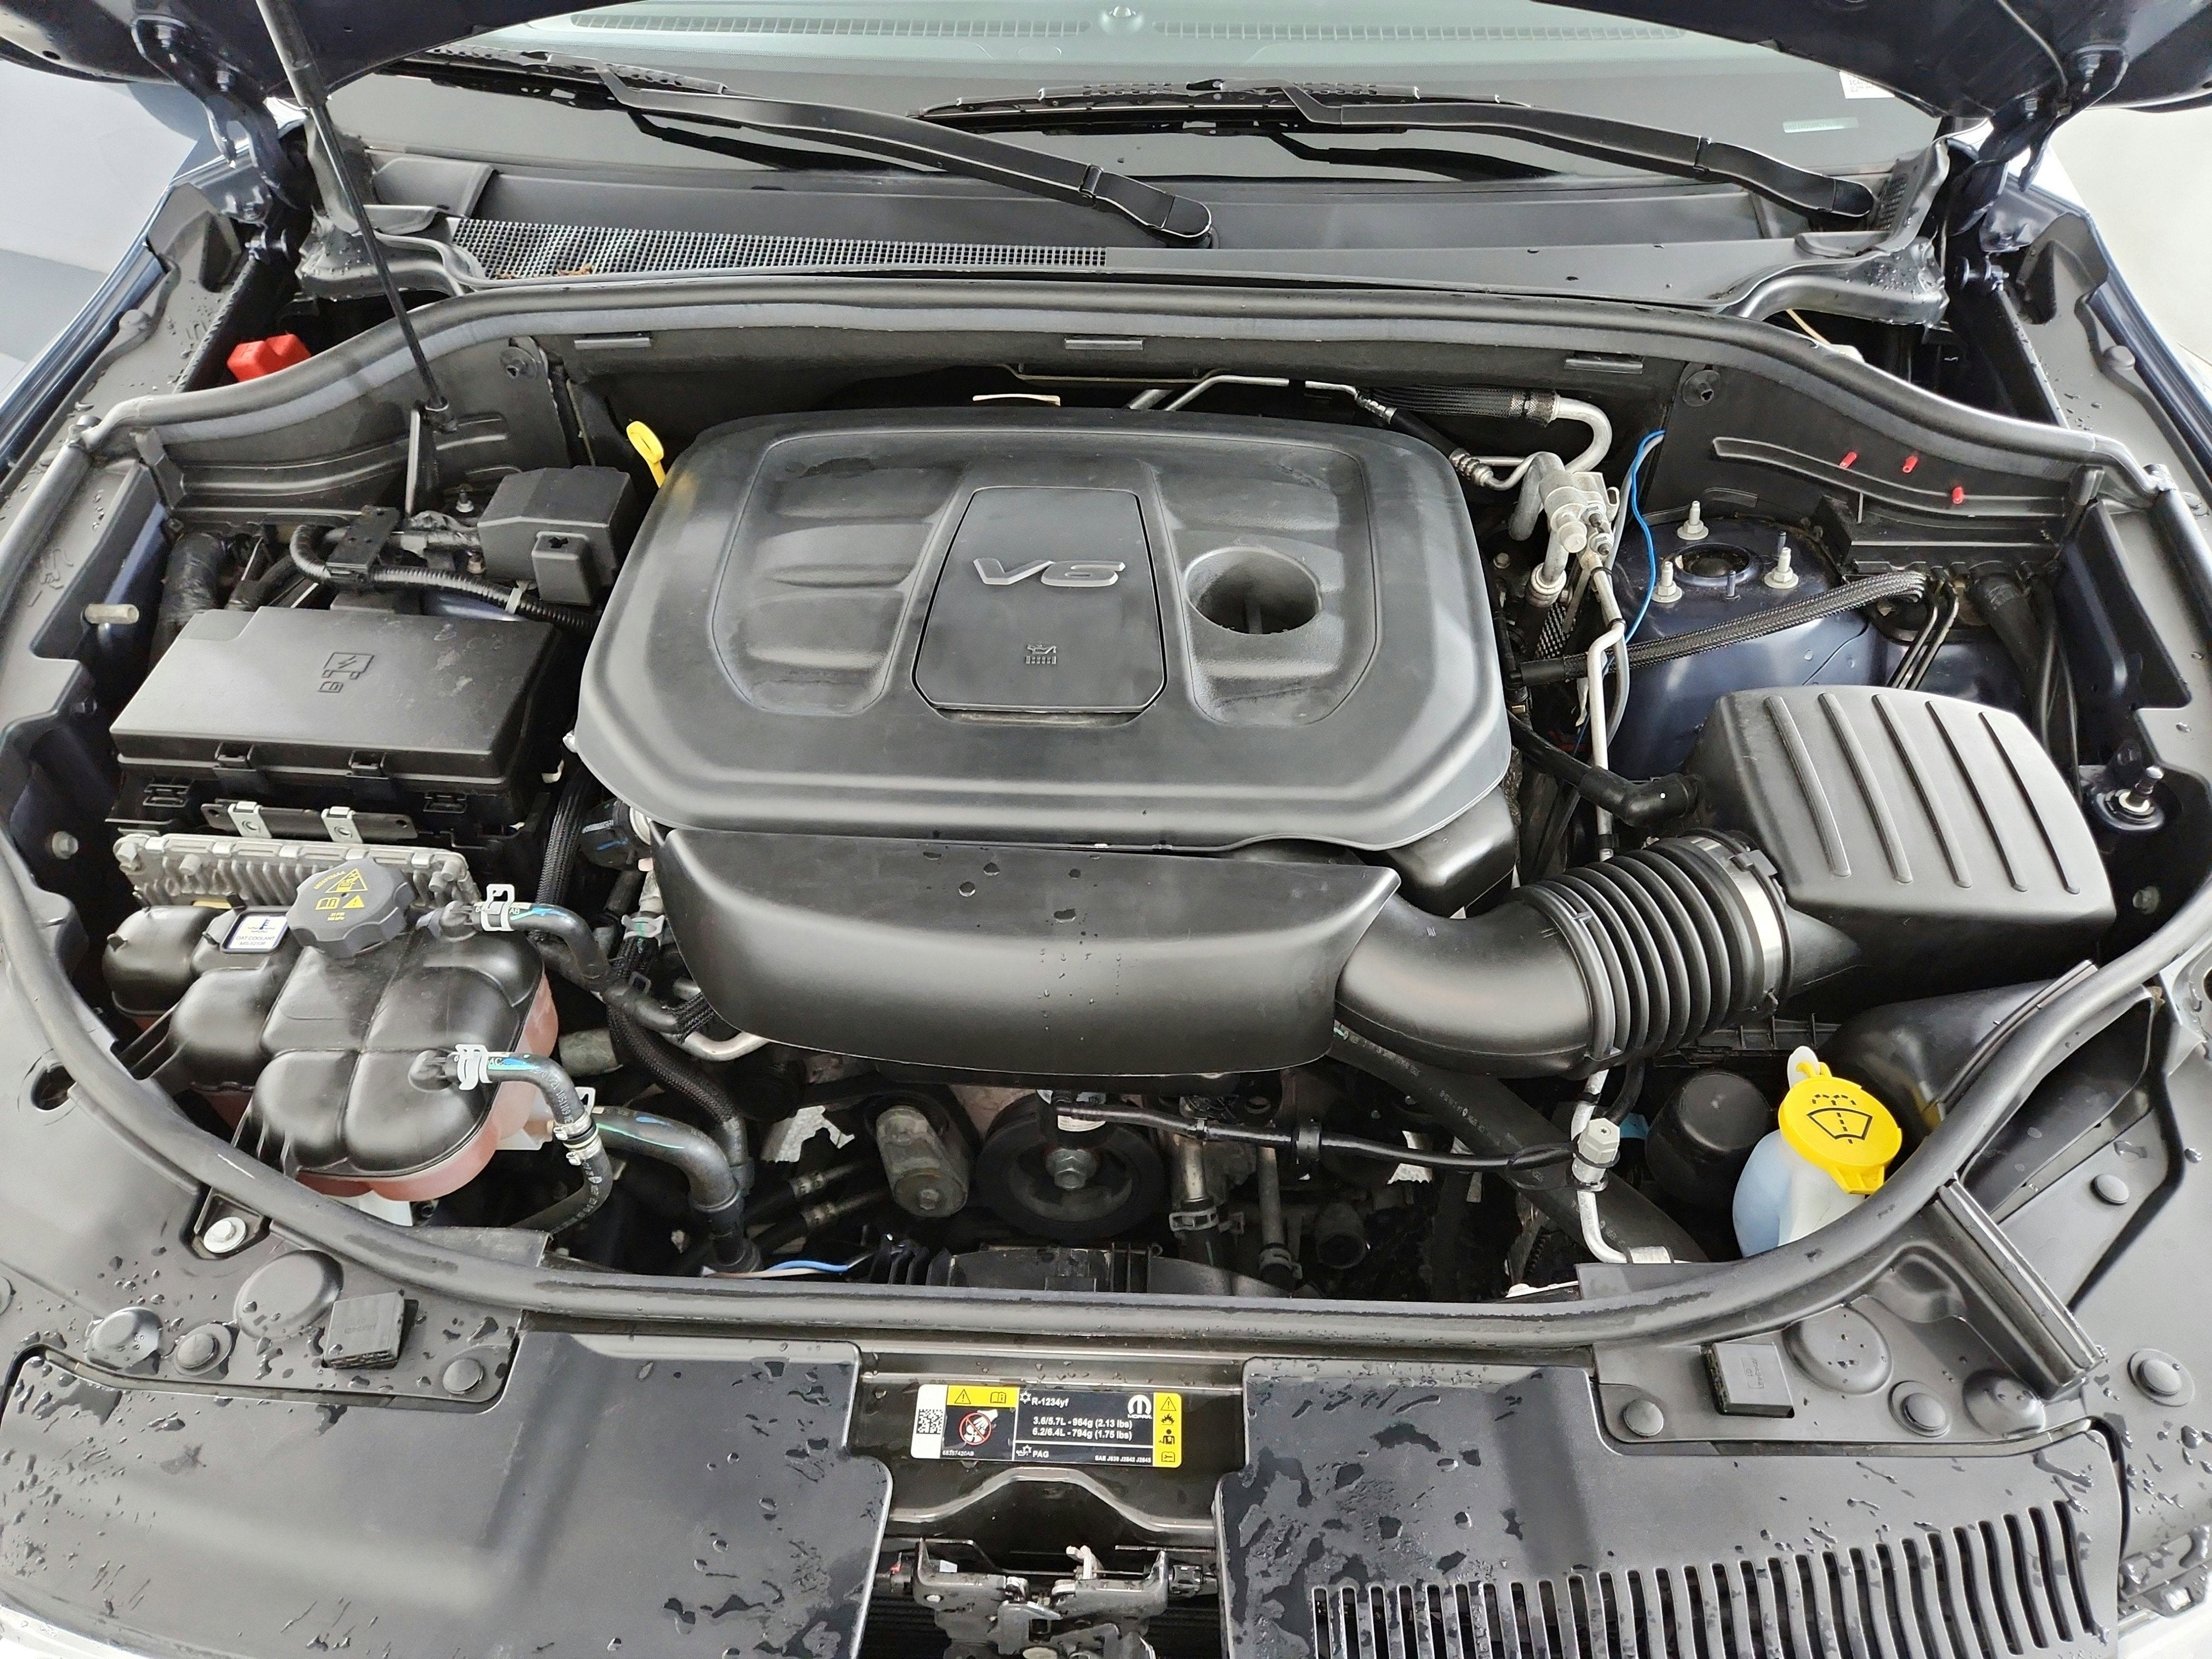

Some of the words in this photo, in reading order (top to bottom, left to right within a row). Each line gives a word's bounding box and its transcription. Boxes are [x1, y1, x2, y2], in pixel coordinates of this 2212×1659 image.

[973, 558, 1126, 587] V6
[1031, 1397, 1069, 1408] R-1234yf
[1033, 1417, 1066, 1426] 3.6/5.7L
[1073, 1418, 1093, 1429] 964g
[1094, 1419, 1115, 1429] (2.13
[1116, 1420, 1132, 1430] lbs)
[1032, 1427, 1065, 1437] 6.2/6.4L
[1073, 1429, 1093, 1440] 794g
[1094, 1429, 1115, 1440] (1.75
[1116, 1430, 1132, 1441] lbs)
[1032, 1450, 1049, 1458] PAG
